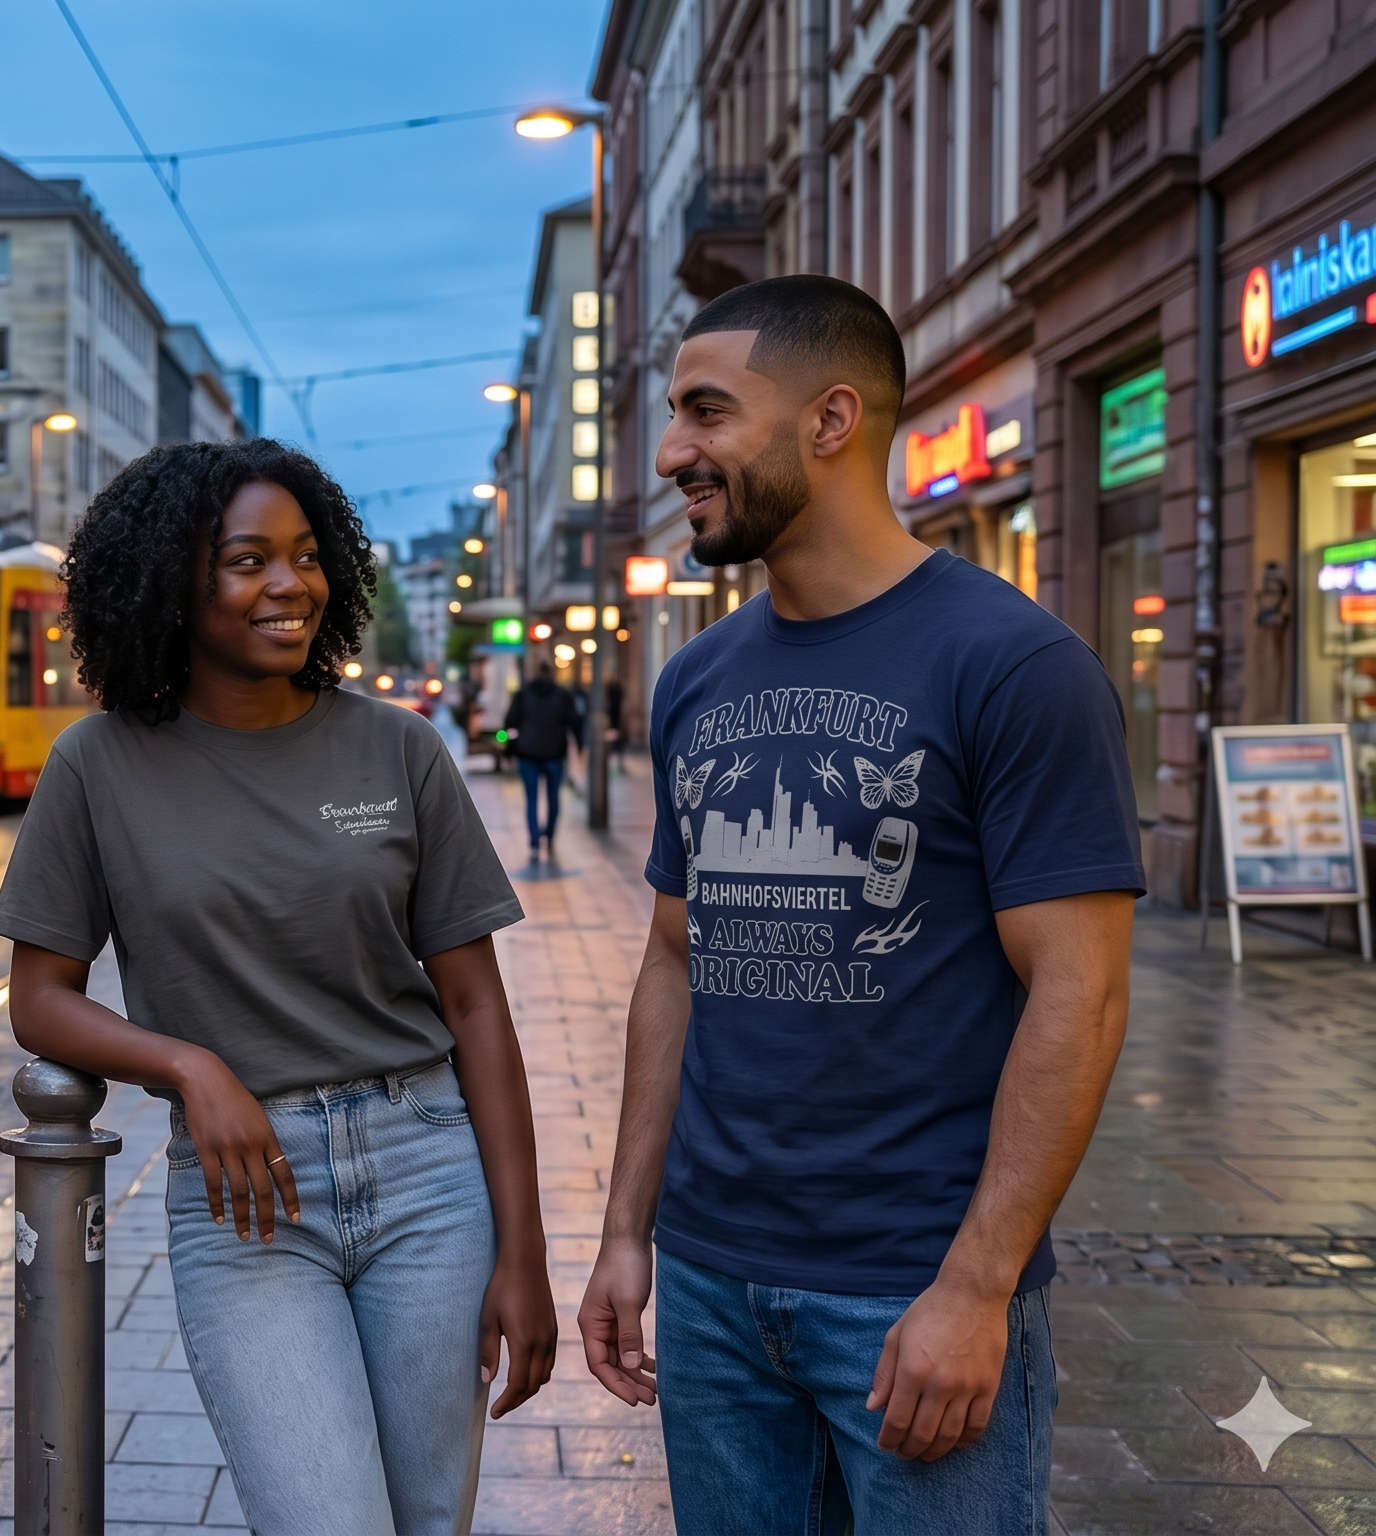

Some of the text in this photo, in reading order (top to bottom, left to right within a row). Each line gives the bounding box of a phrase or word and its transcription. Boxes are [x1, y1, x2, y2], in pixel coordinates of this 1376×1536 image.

[688, 688, 908, 756] FRANKFURT
[701, 882, 852, 911] BAHNHOFSVIERTEL
[708, 917, 835, 956] ALWAYS
